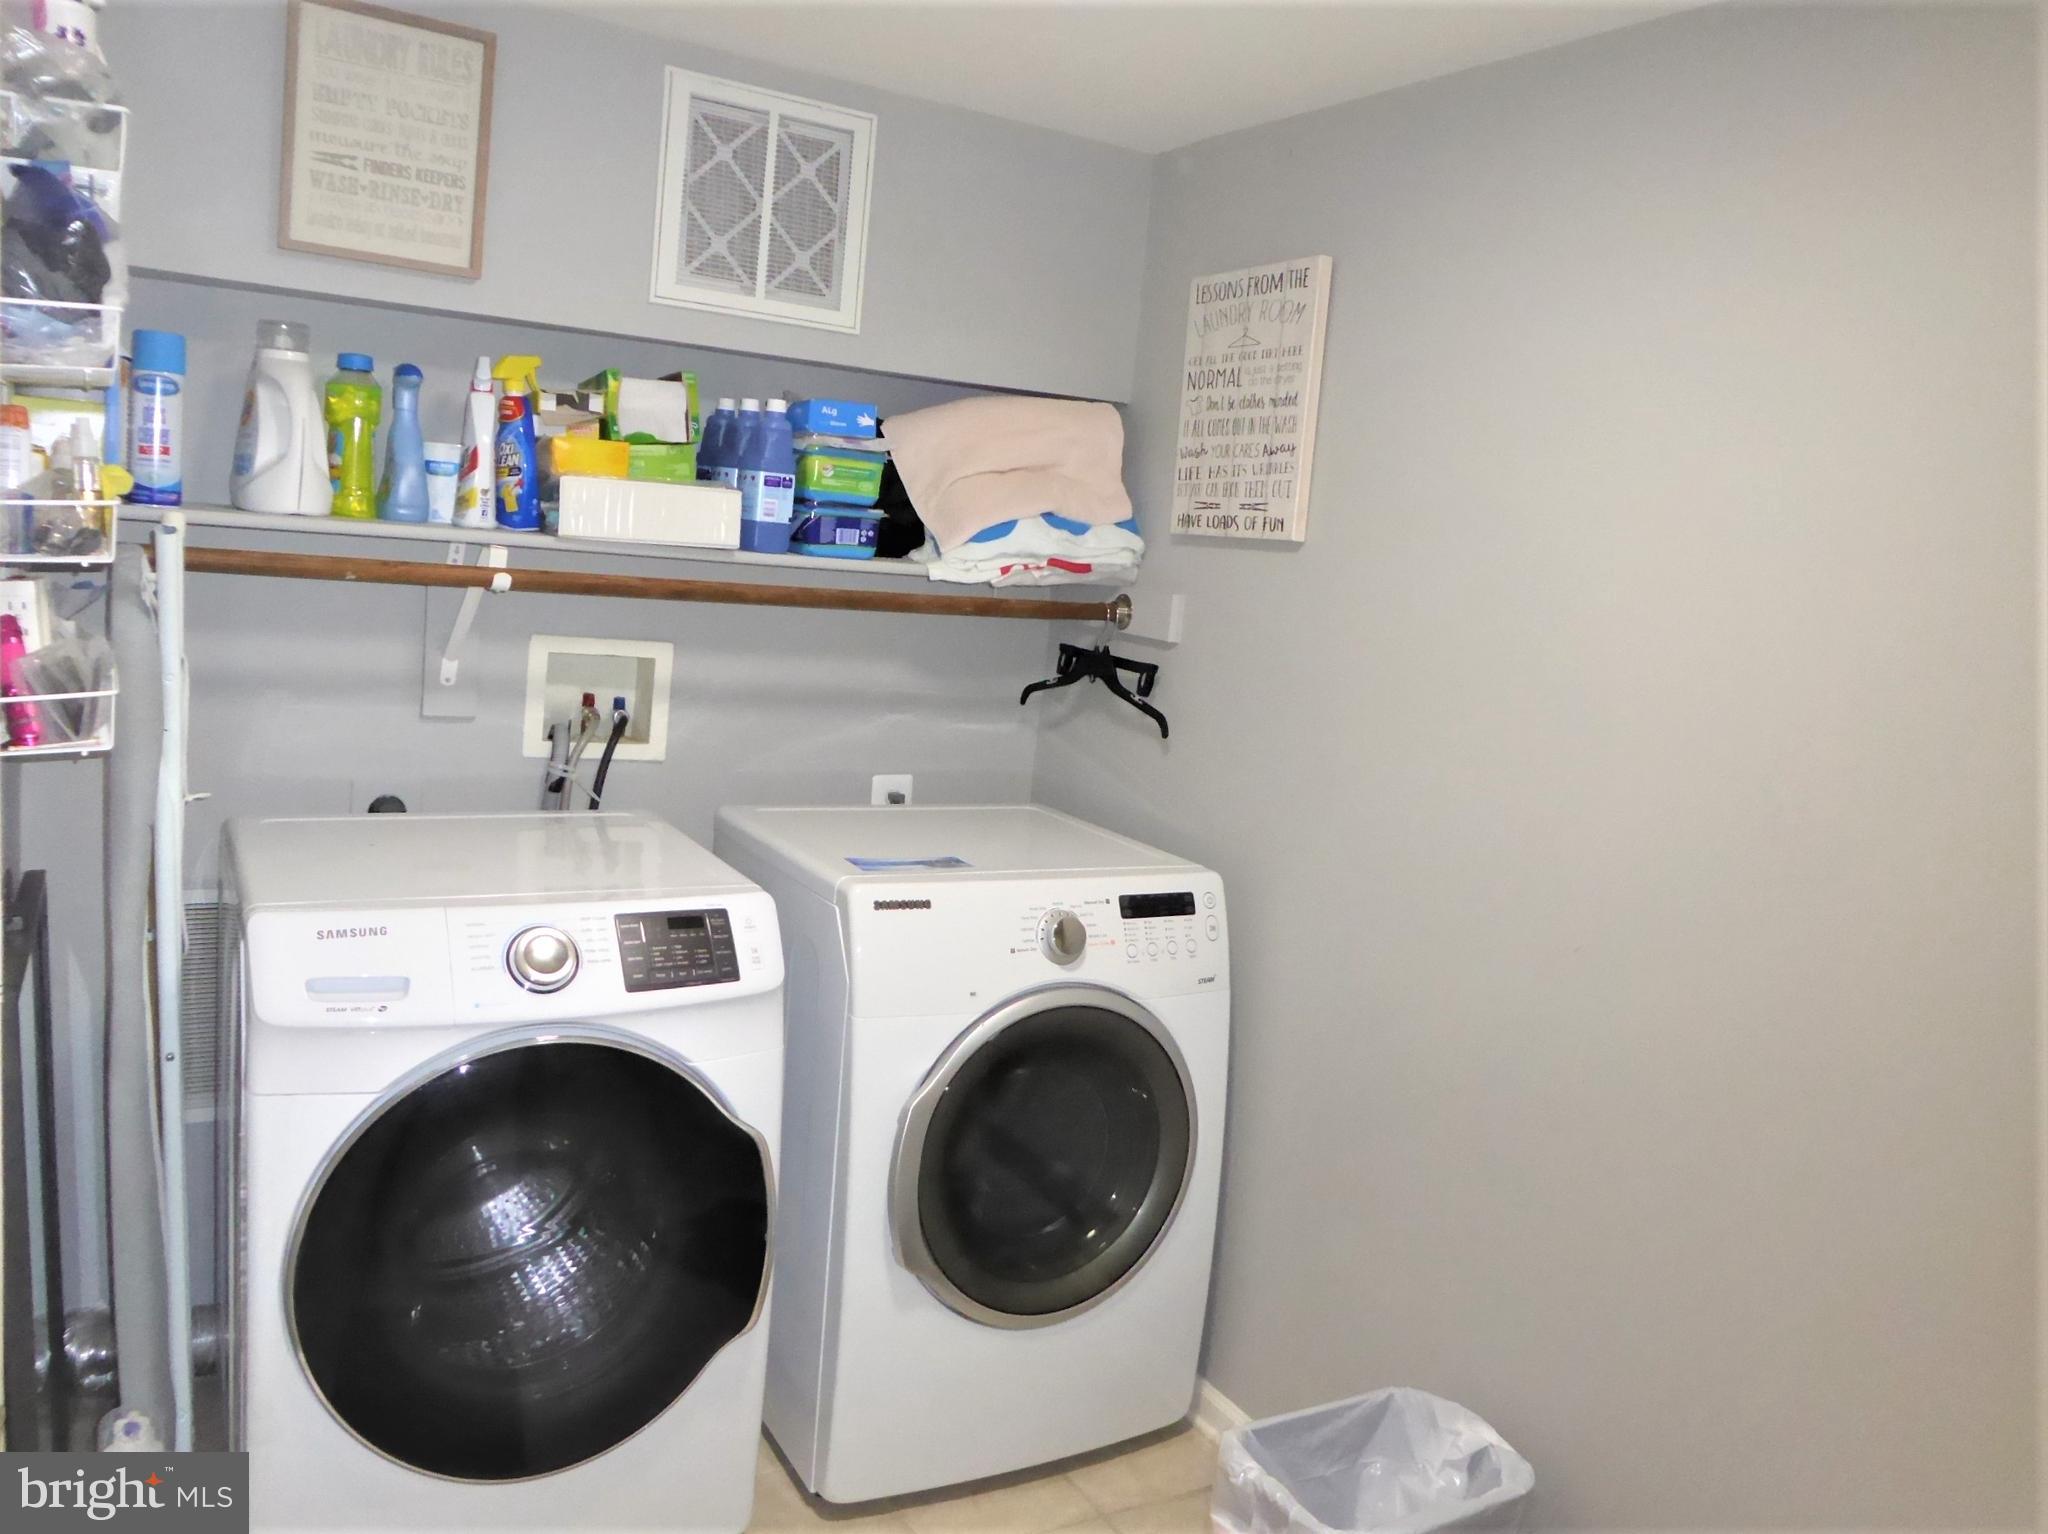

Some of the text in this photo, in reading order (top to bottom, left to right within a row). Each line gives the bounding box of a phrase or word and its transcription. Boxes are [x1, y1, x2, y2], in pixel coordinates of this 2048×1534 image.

[362, 158, 467, 190] FINDERS KEEPERS
[309, 169, 359, 195] WASH
[368, 179, 421, 207] RINSE
[427, 191, 465, 215] DRY
[1196, 267, 1310, 305] LESSONS FROM THE
[1194, 299, 1306, 338] LAUNDRY ROOM
[1187, 367, 1242, 391] NORMAL
[1180, 441, 1208, 459] Wash
[1211, 443, 1232, 459] YOUR
[1233, 441, 1261, 458] CARES
[1178, 466, 1201, 481] LIFE
[1208, 465, 1228, 479] HAS
[1177, 513, 1285, 532] HAVE LOADS OF FUN
[872, 899, 931, 911] SAMSUNG
[316, 926, 388, 940] SAMSUNG
